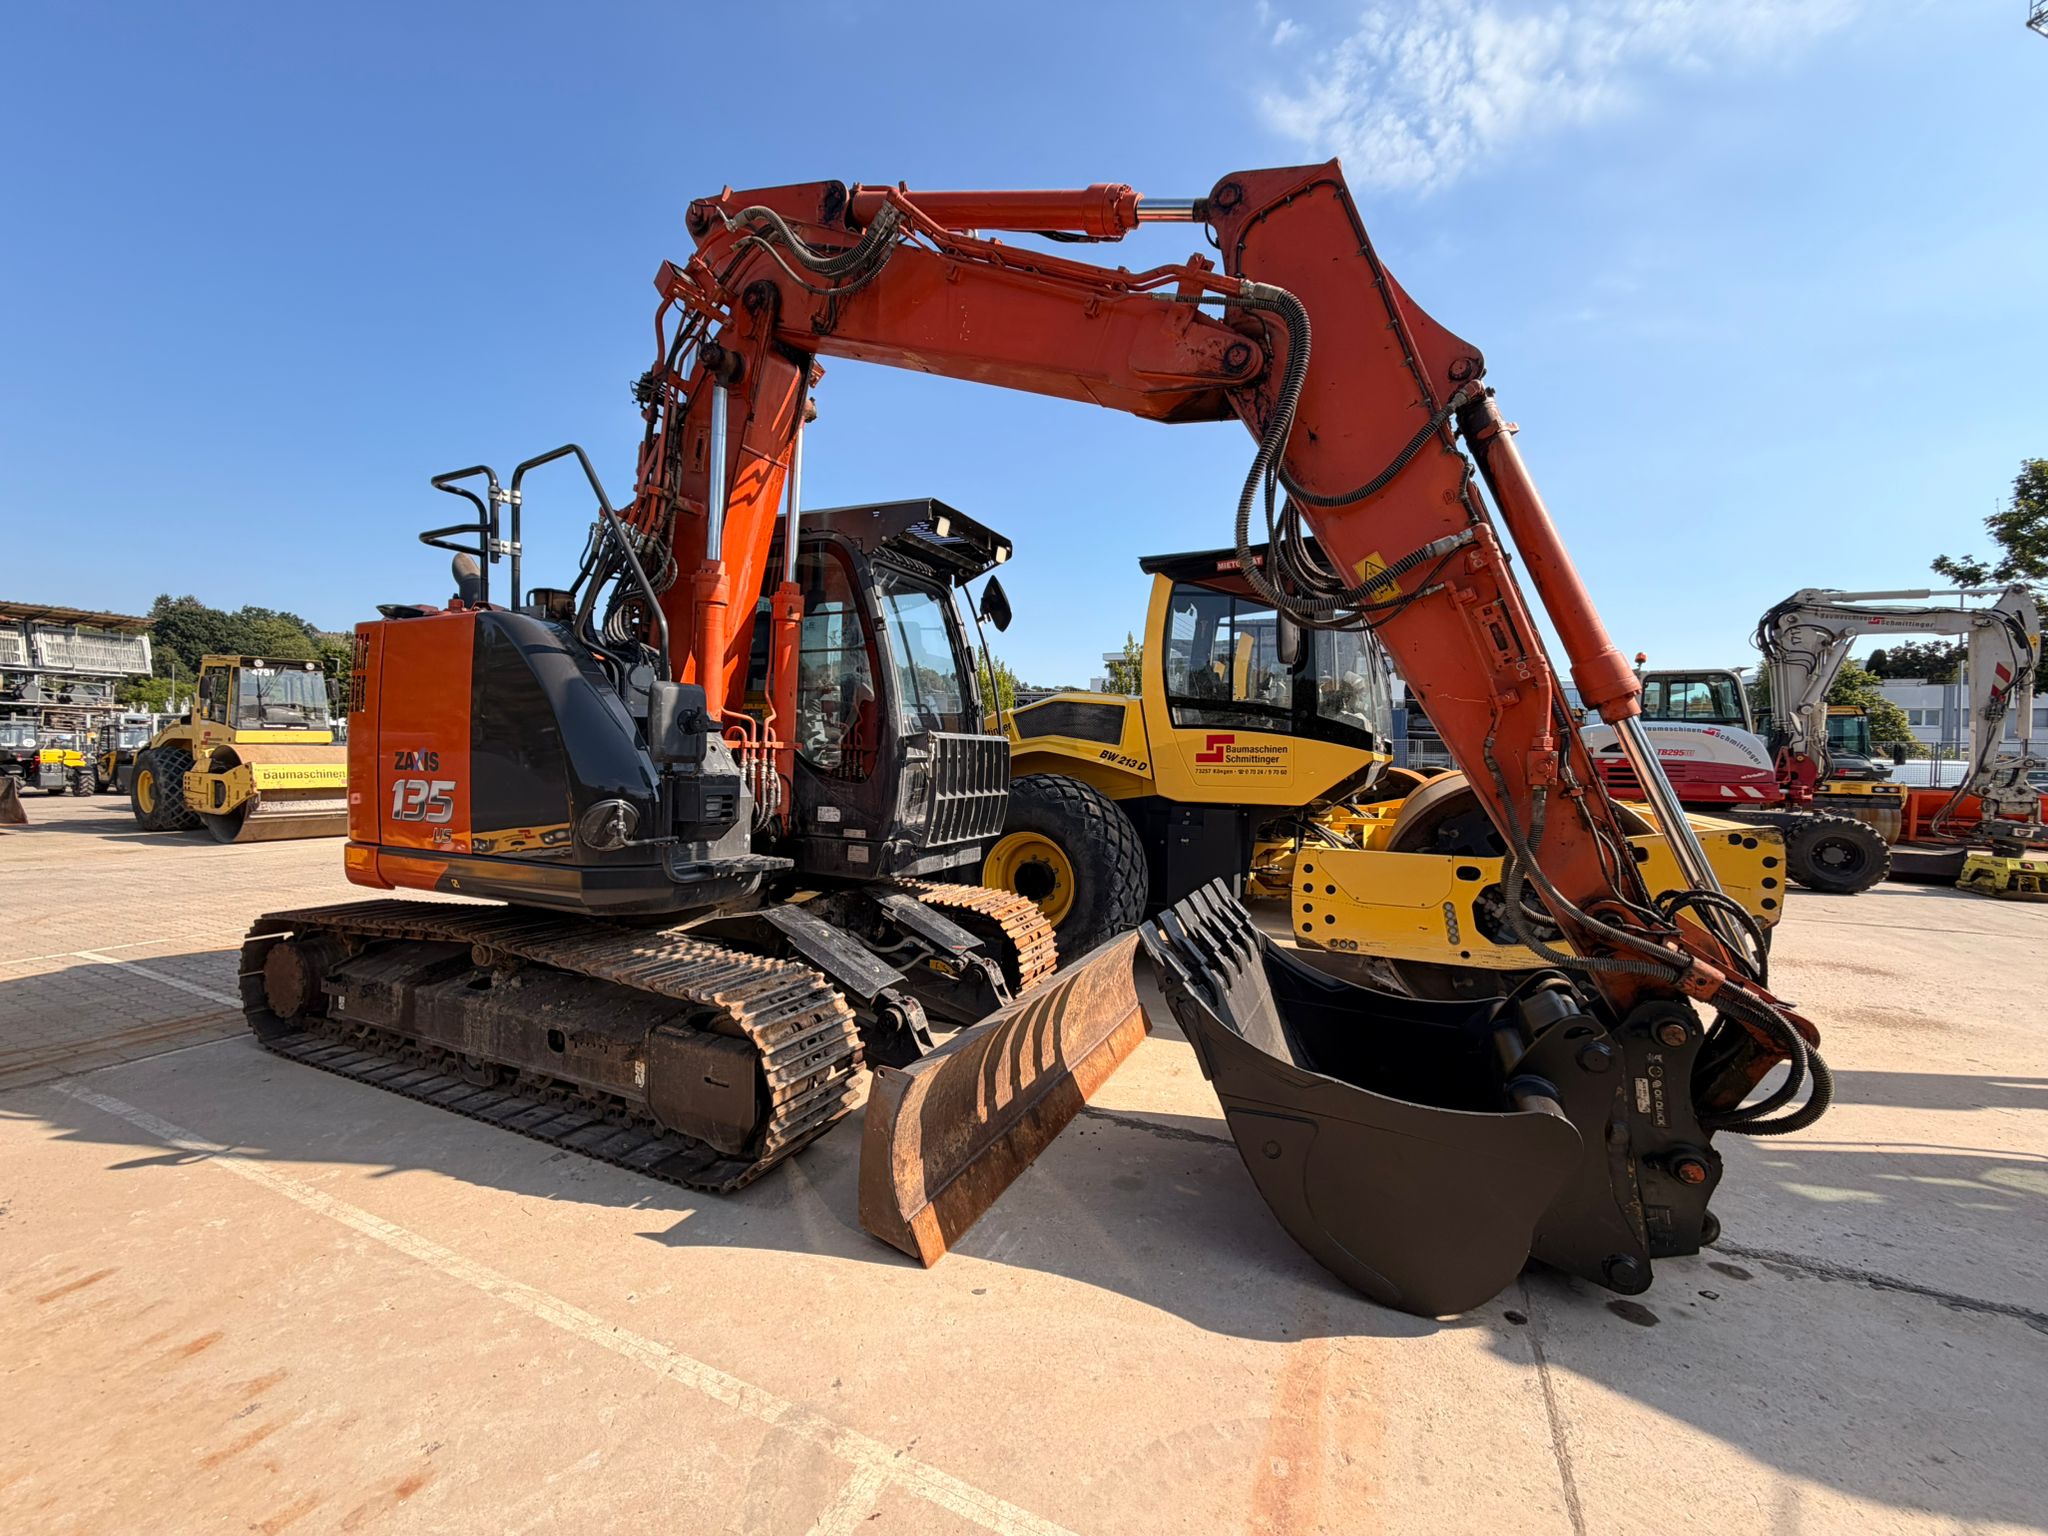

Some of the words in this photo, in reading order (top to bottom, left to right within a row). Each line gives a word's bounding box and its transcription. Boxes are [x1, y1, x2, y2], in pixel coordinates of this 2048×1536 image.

[1880, 619, 1935, 628] Schmittinger
[251, 668, 275, 677] 4791
[1226, 745, 1288, 753] Baumaschinen
[1715, 732, 1762, 765] Schmittinger
[394, 748, 439, 772] ZAXIS
[1099, 749, 1120, 762] BW
[1117, 755, 1138, 768] 213
[1137, 761, 1148, 771] D
[1225, 755, 1280, 764] Schmittinger
[263, 769, 346, 780] Baumaschinen
[391, 779, 456, 824] 135
[432, 827, 453, 844] US
